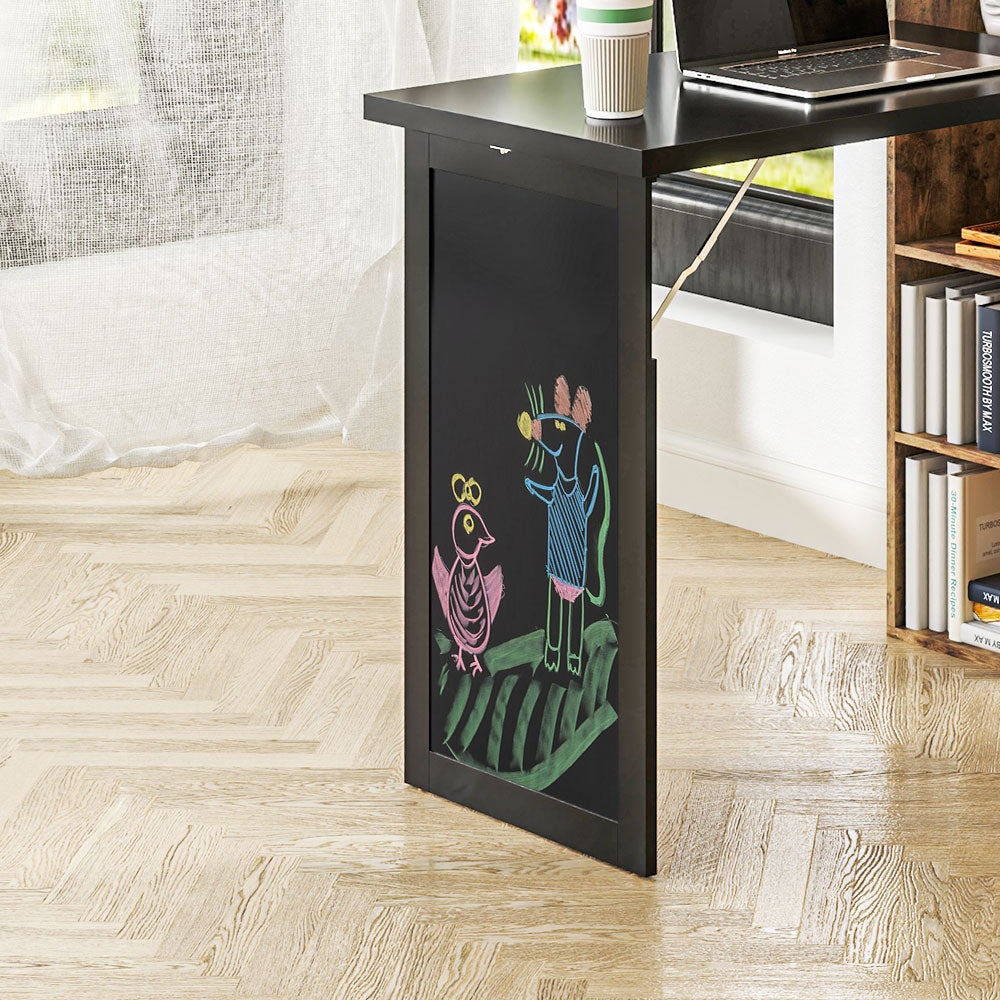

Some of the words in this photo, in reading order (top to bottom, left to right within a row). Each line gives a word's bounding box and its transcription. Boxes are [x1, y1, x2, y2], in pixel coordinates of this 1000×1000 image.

[981, 331, 993, 397] TURBOSMOOTH
[981, 397, 993, 411] BY
[992, 640, 1000, 649] BY
